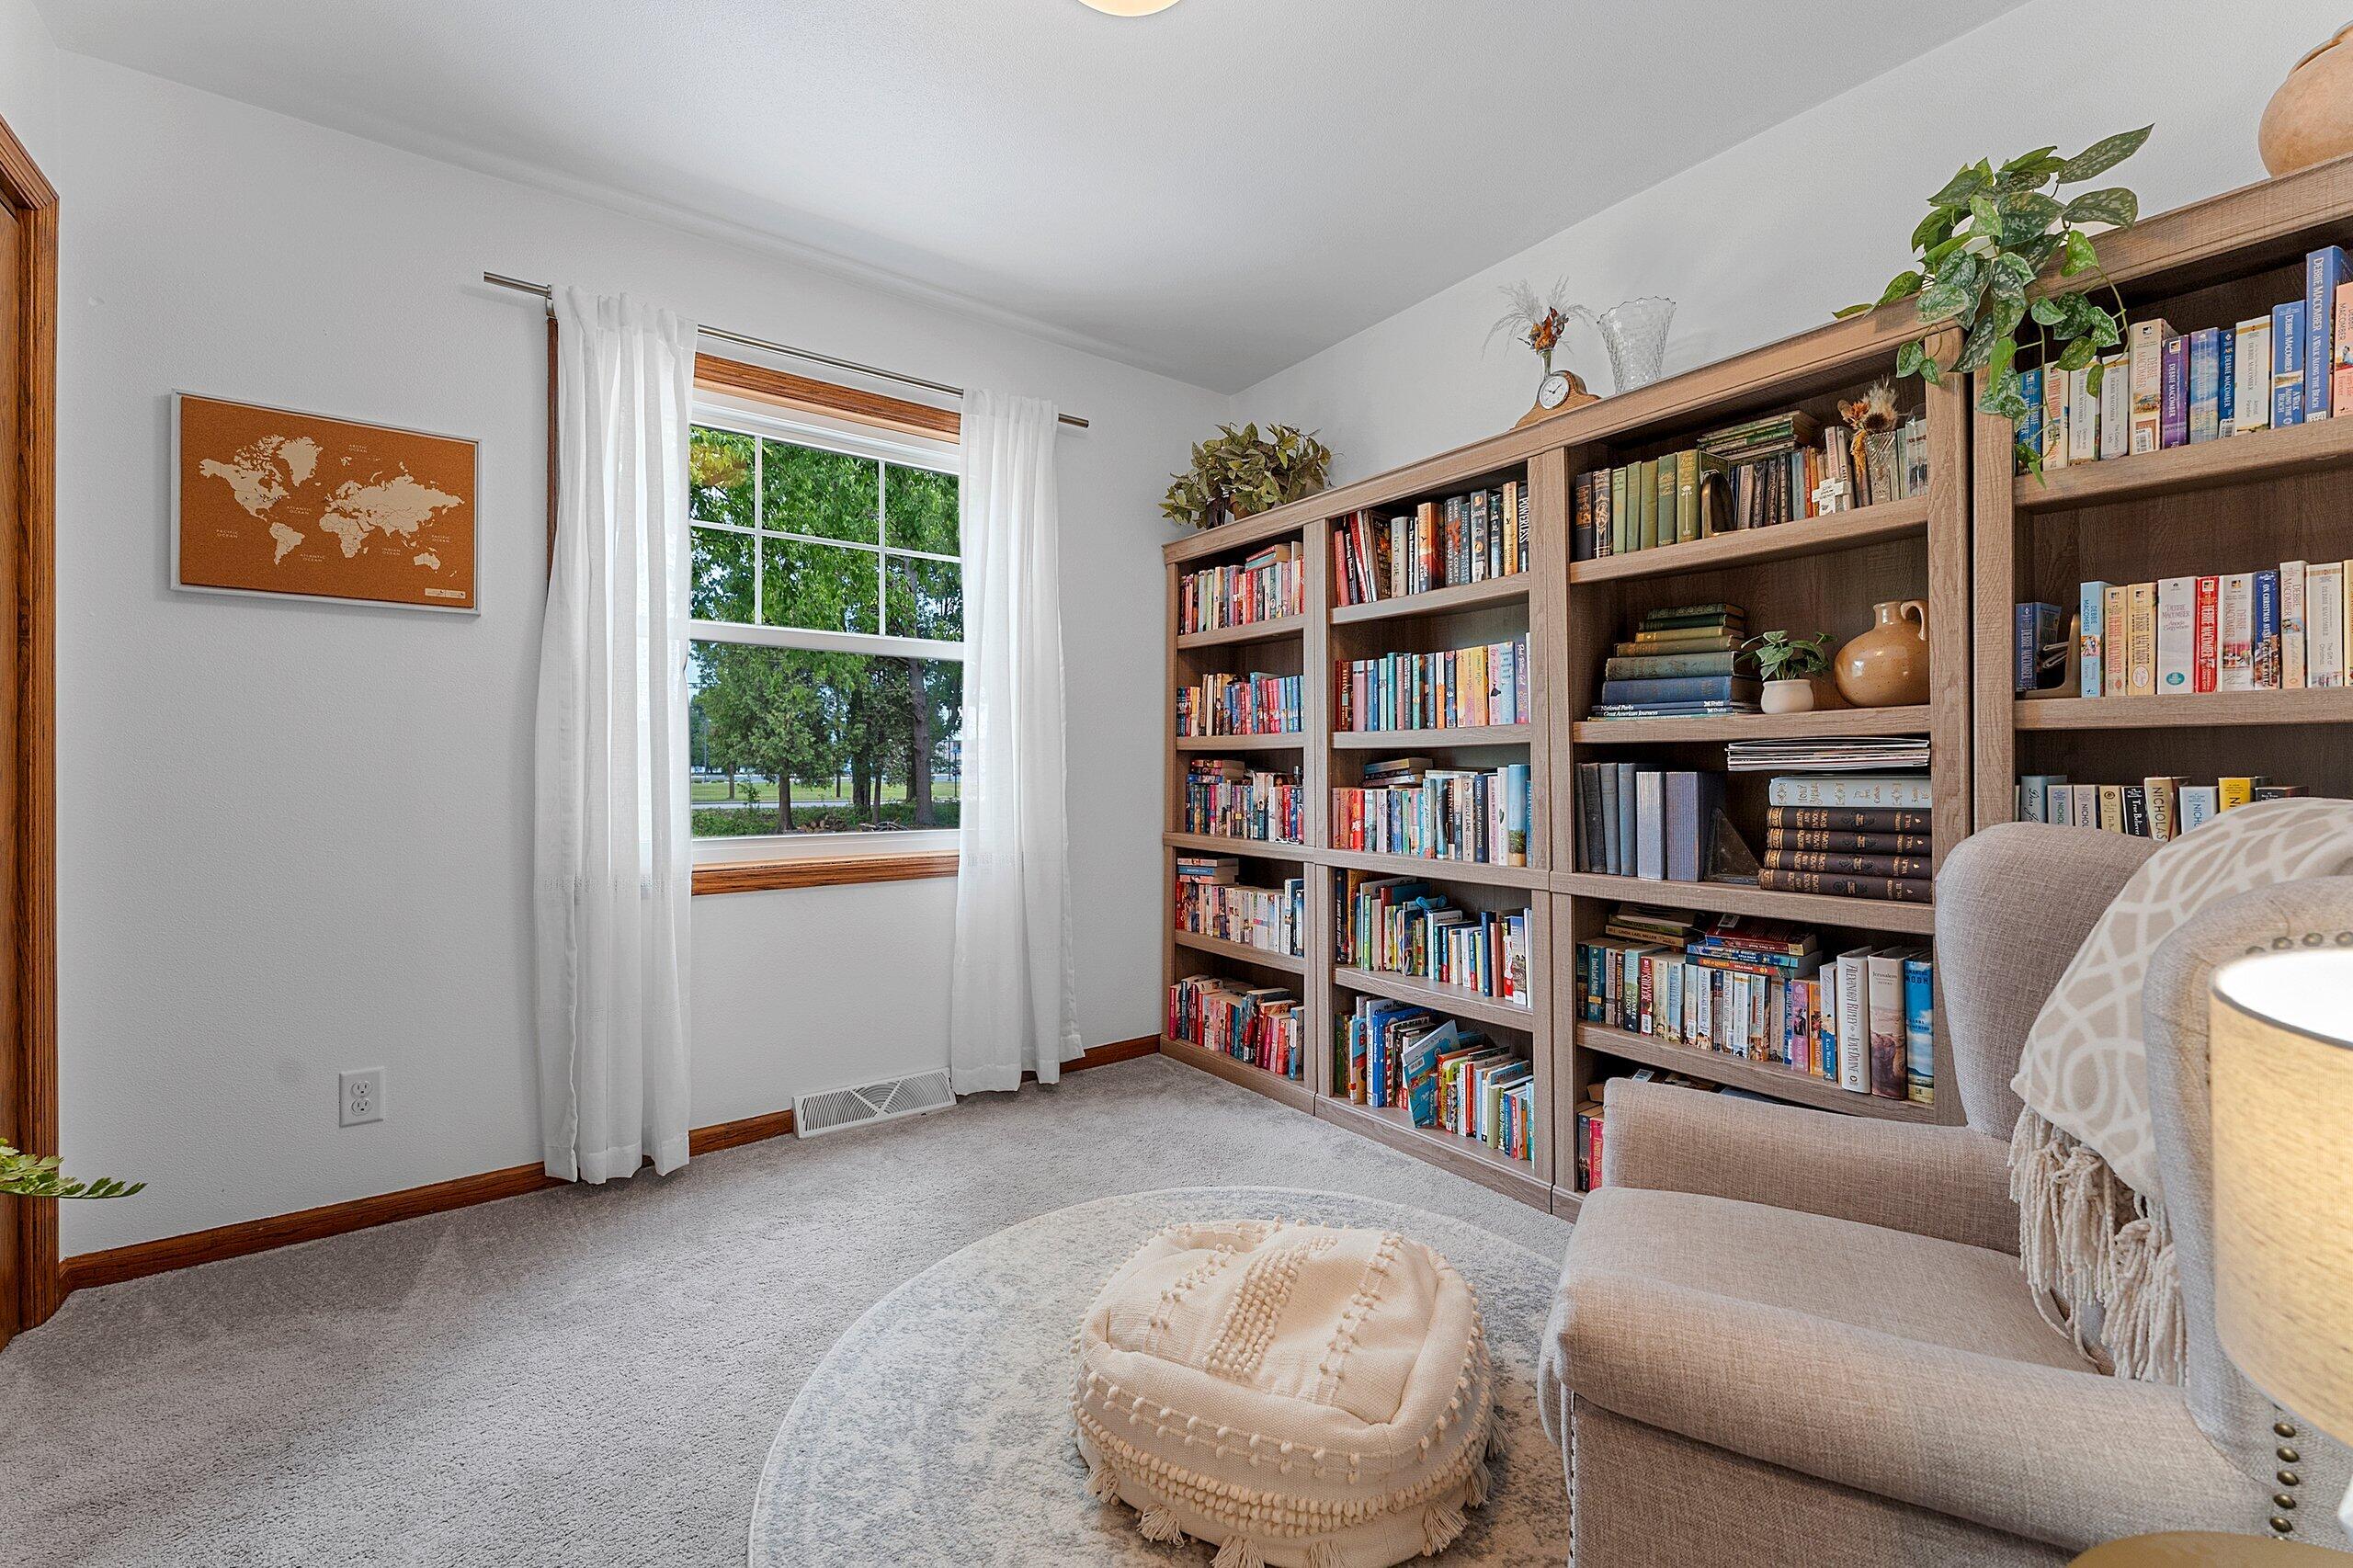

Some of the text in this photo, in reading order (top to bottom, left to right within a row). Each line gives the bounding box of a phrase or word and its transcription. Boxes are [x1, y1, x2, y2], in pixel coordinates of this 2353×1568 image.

[2313, 257, 2324, 331] DEBBIE MACOMBER
[2285, 315, 2294, 371] DEBBIE MACOMBER
[1518, 497, 1529, 543] POWERLESS
[2153, 787, 2167, 840] NICHOLAS
